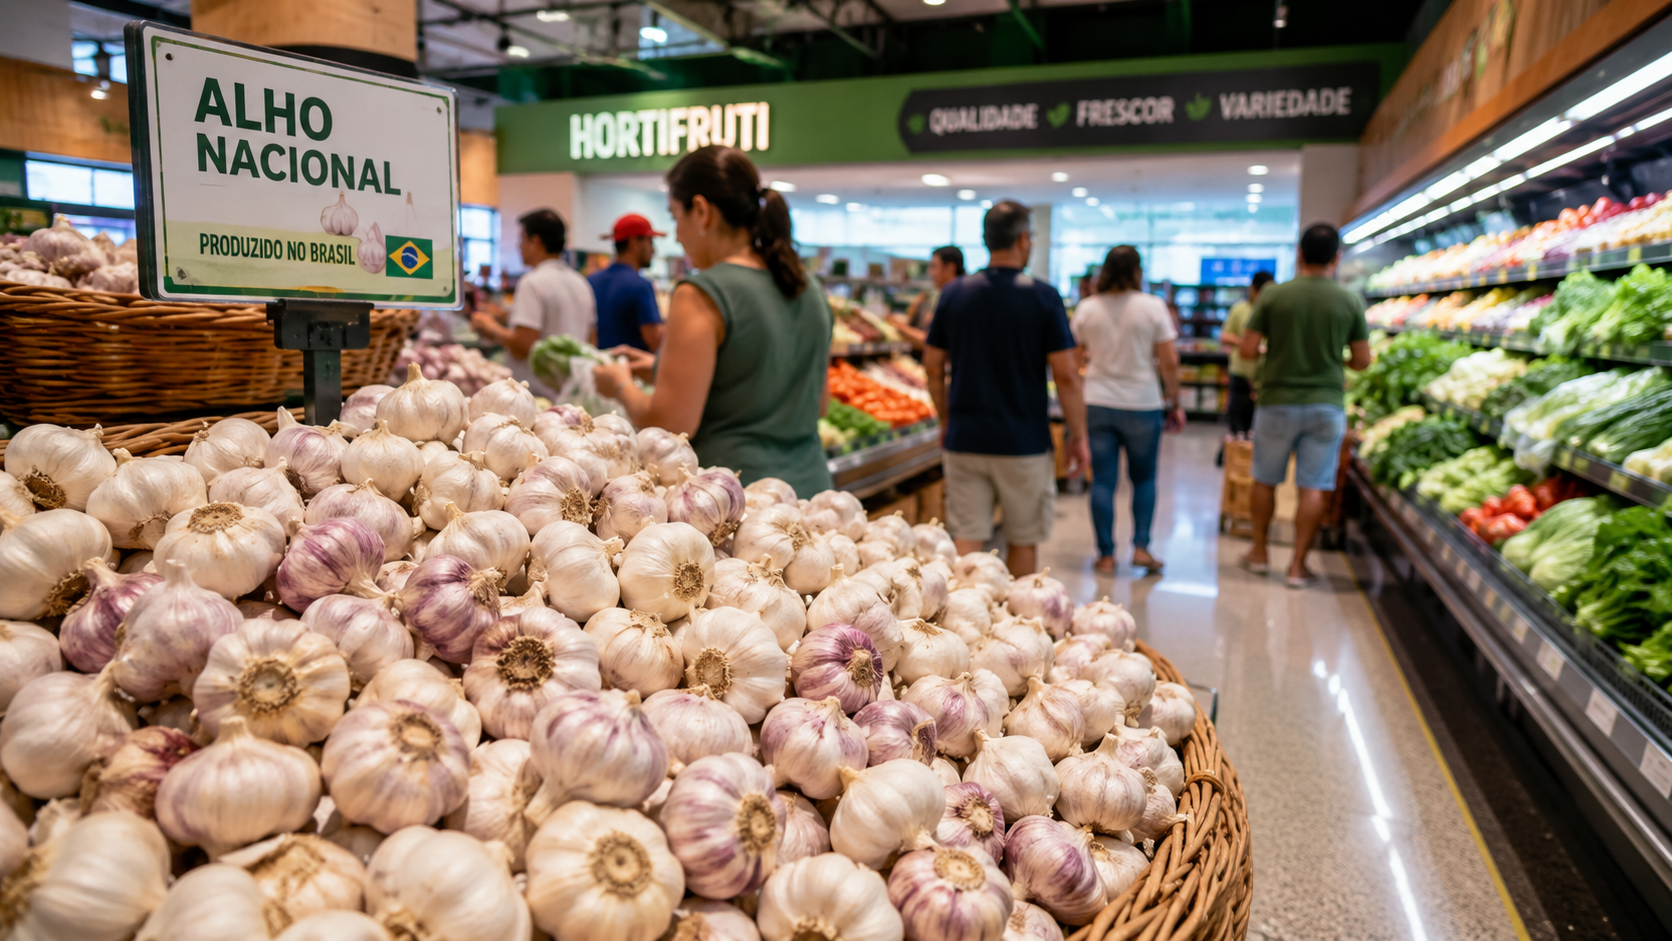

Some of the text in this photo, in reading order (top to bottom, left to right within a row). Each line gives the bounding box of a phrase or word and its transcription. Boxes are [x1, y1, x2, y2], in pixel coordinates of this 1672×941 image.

[194, 77, 332, 141] ALHO
[569, 102, 769, 159] HORTIFRUTI
[930, 88, 1352, 135] QUALIDADE FRESCOR VARIEDADE
[196, 132, 401, 196] NACIONAL
[199, 233, 355, 265] PRODUZIDO NO BRASIL
